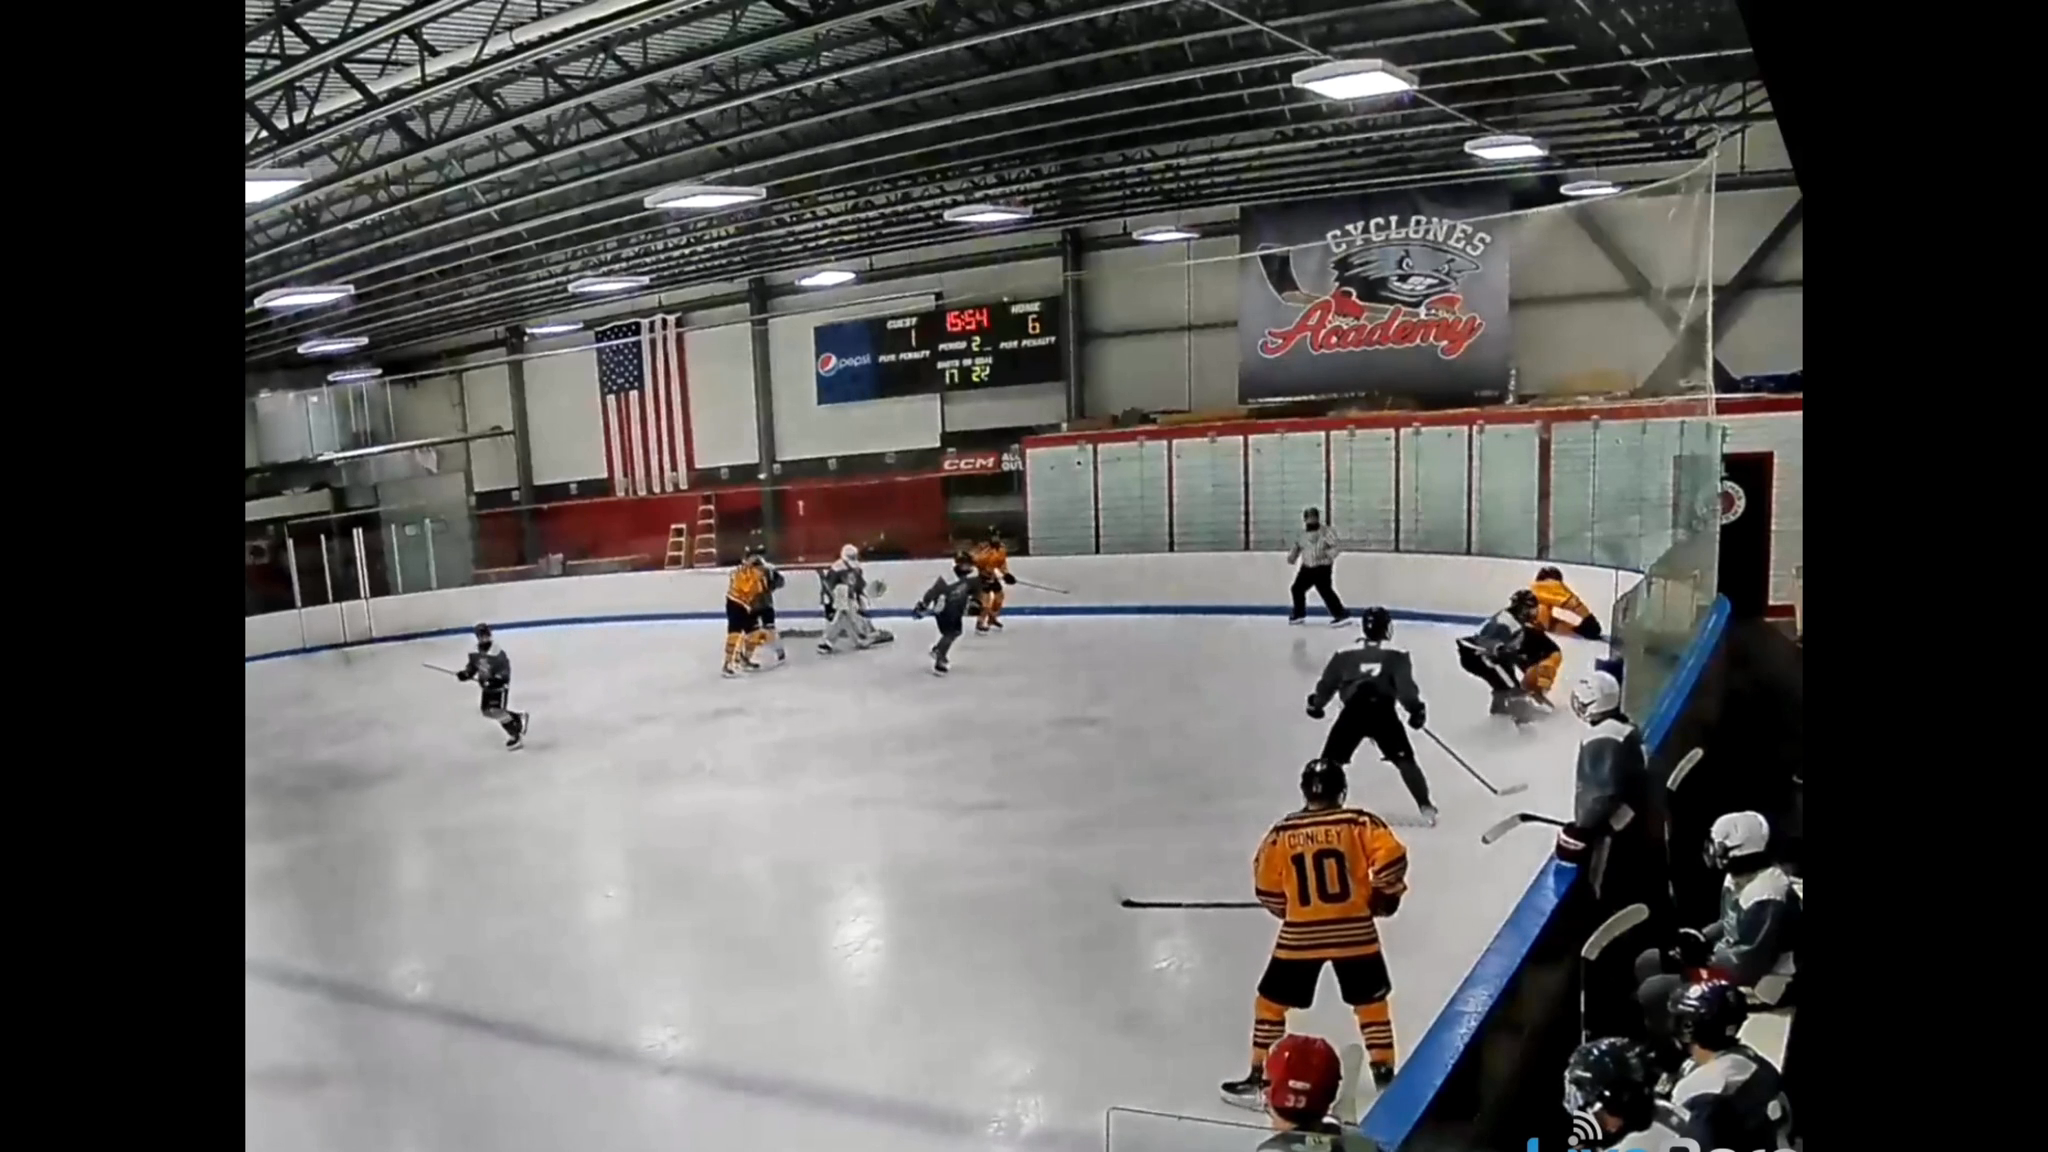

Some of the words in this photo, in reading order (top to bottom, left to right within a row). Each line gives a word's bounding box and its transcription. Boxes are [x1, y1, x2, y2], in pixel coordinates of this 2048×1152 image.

[1326, 214, 1492, 257] CYCLONES
[946, 307, 988, 332] 15:54
[1028, 314, 1041, 335] 6
[1258, 296, 1485, 360] Academy
[971, 336, 982, 352] 2
[838, 353, 872, 370] pepsi
[945, 368, 959, 385] 17
[943, 457, 996, 470] CCM
[1001, 452, 1021, 462] ALL
[1288, 828, 1343, 848] CONLEY
[1290, 848, 1352, 907] 10
